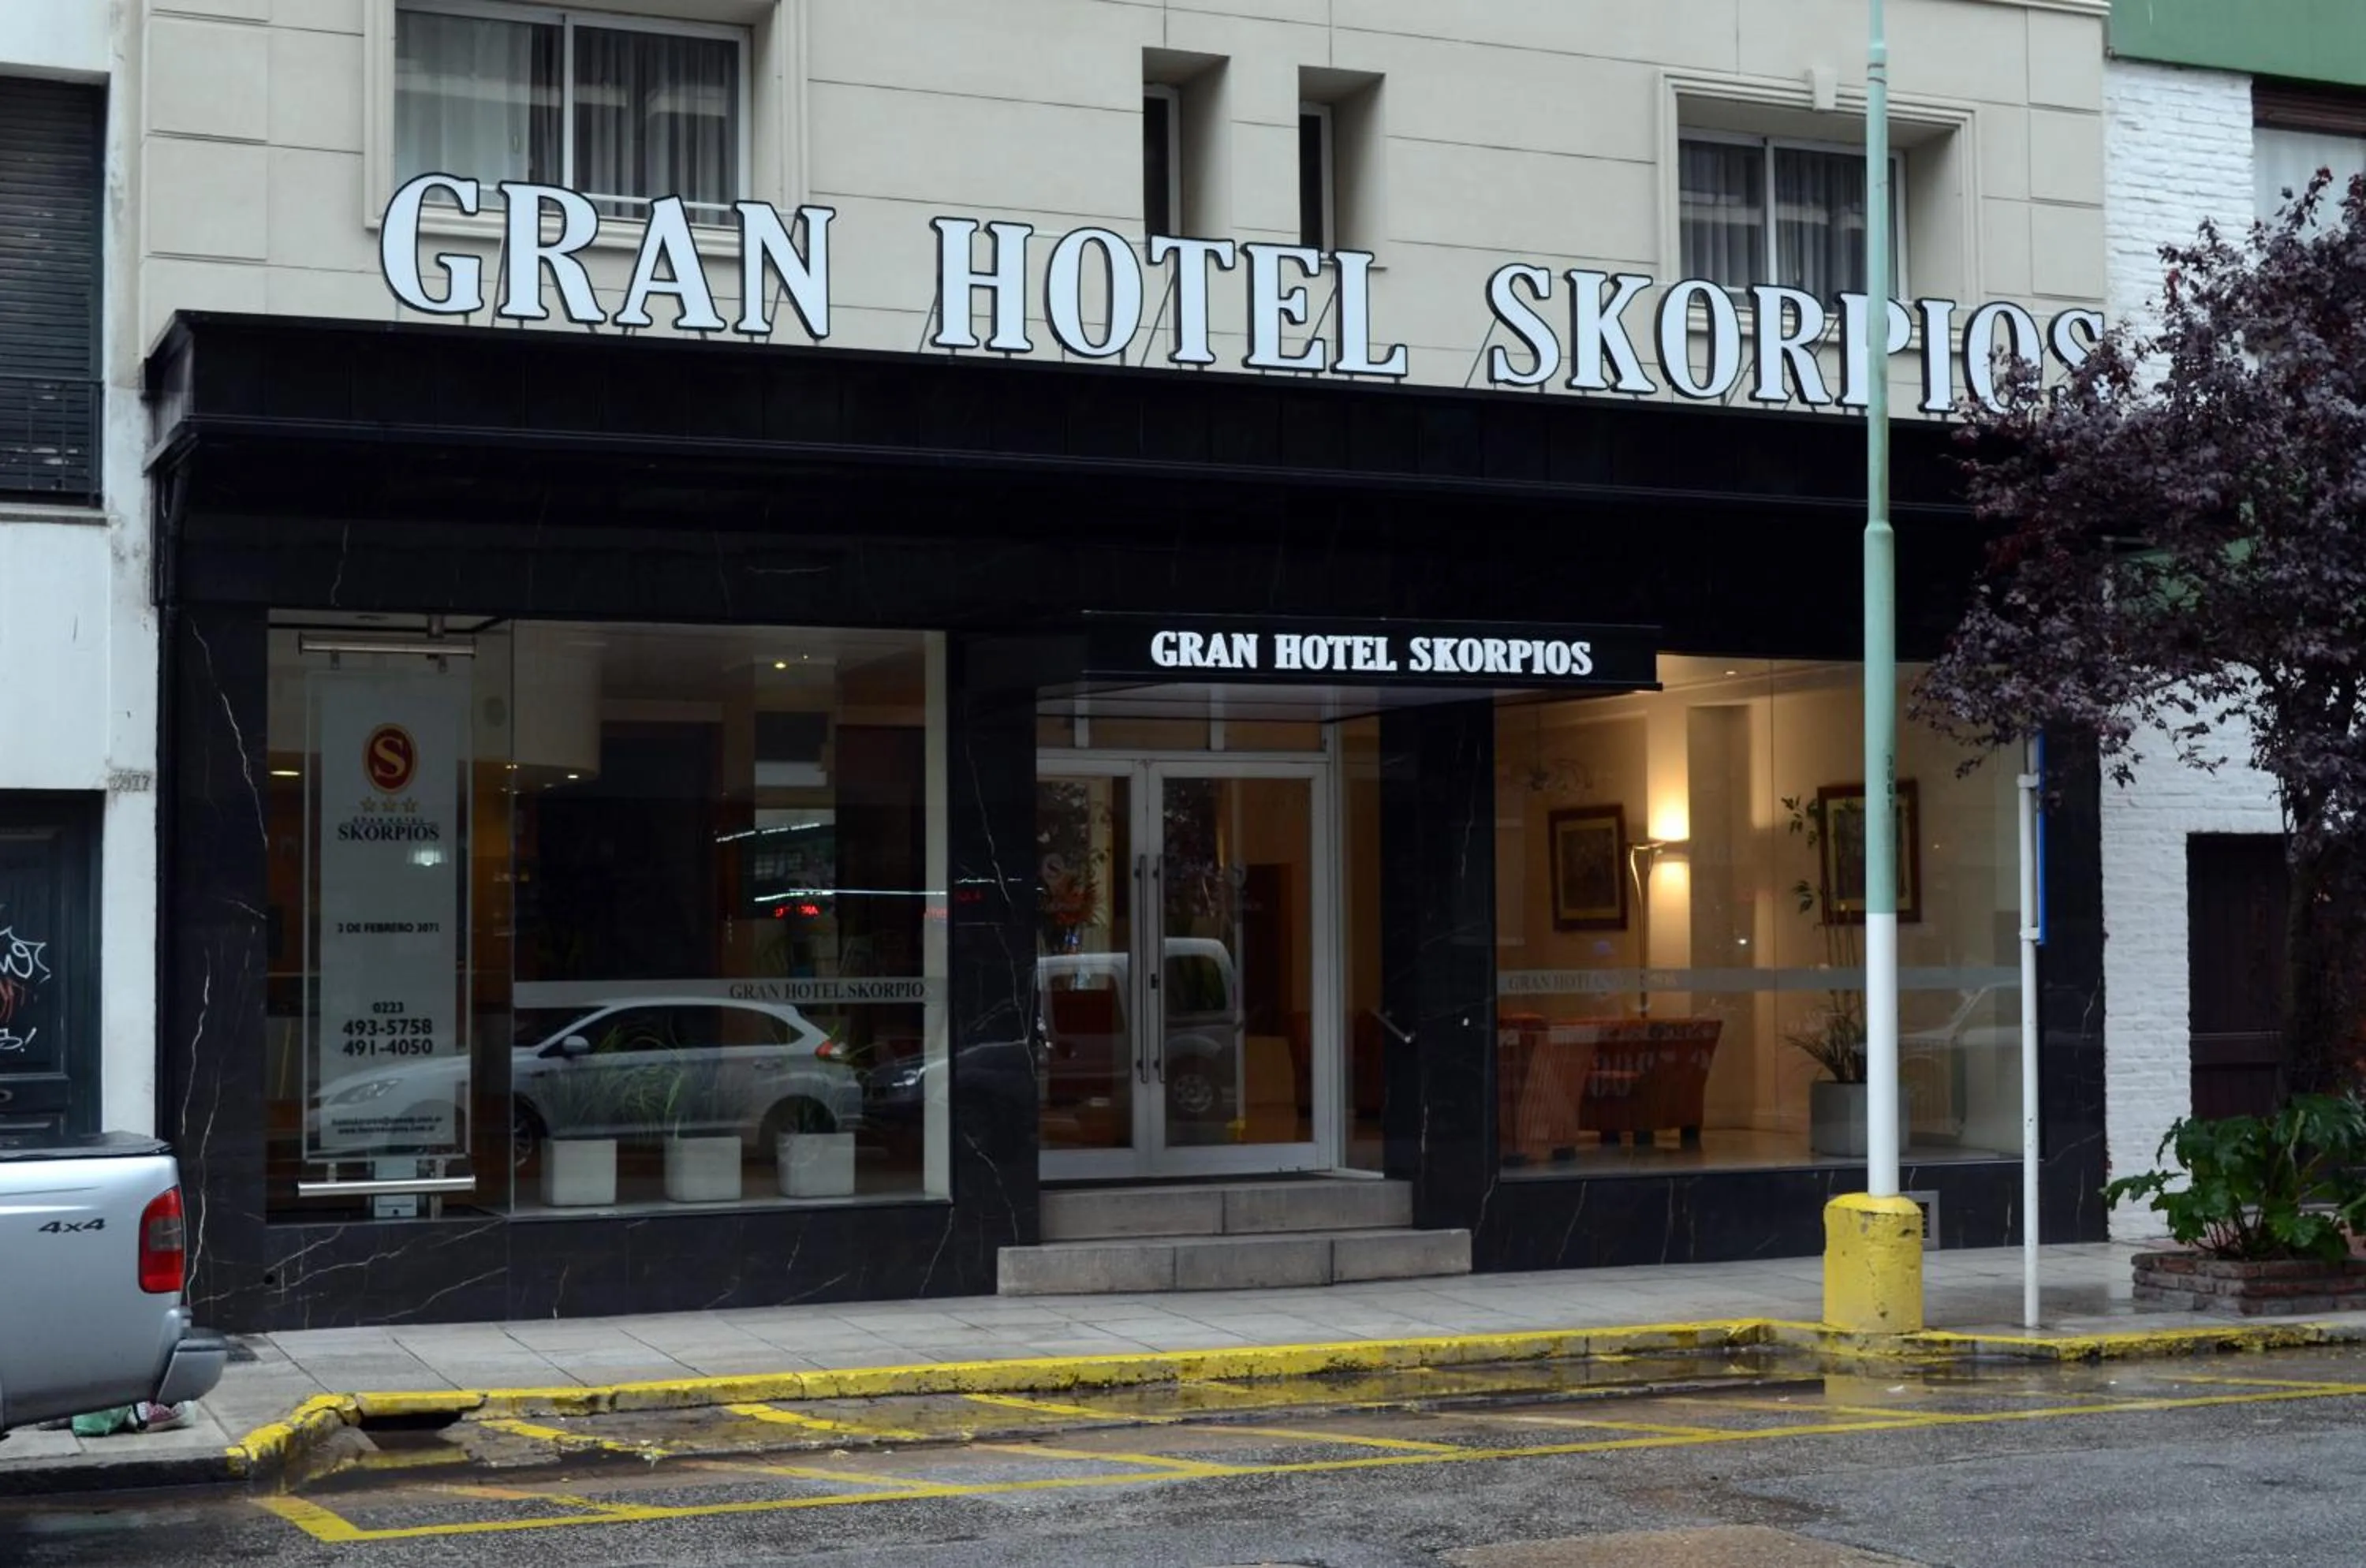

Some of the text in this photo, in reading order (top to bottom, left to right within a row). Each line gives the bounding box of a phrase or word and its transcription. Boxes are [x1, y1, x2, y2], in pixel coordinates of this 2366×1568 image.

[379, 171, 2108, 414] GRAN HOTEL SKORPIOS
[1151, 631, 1594, 676] GRAN HOTEL SKORPIOS
[374, 736, 406, 778] S
[338, 822, 440, 842] SKORPIOS
[345, 922, 361, 934] DE
[364, 921, 414, 934] FEBRERO
[729, 980, 934, 1000] GRAN HOTEL SKORPIO
[372, 1001, 405, 1014] 0223
[342, 1018, 433, 1036] 493-5758
[342, 1038, 433, 1056] 491-4050
[38, 1218, 106, 1234] 4x4
